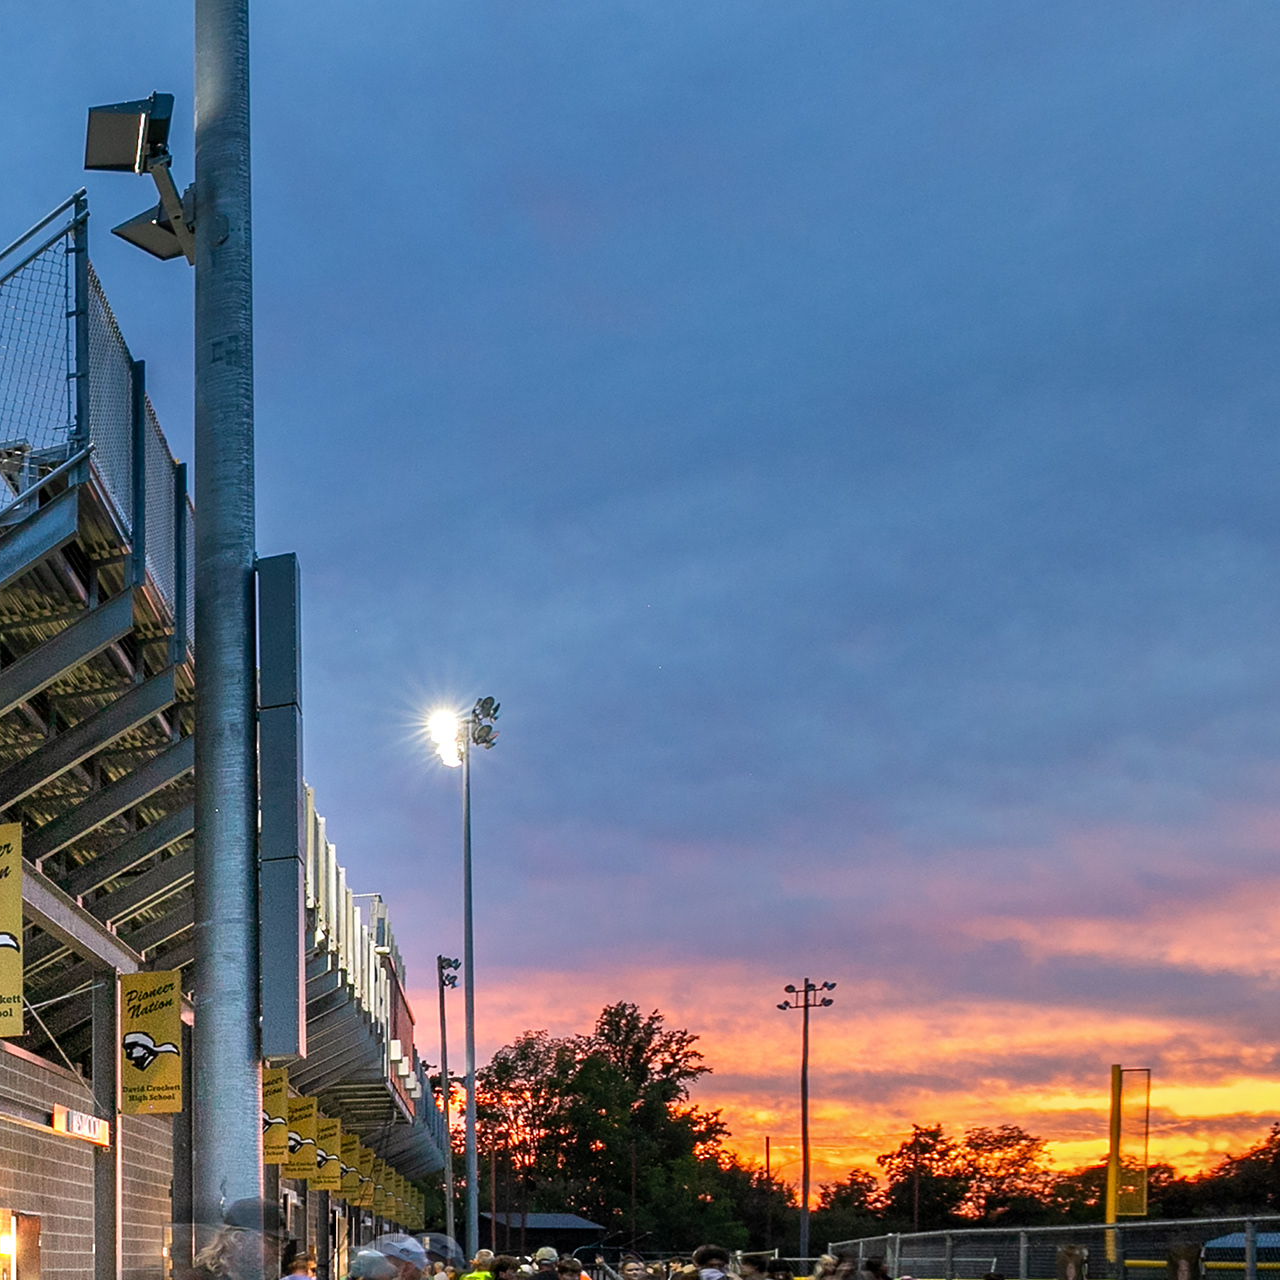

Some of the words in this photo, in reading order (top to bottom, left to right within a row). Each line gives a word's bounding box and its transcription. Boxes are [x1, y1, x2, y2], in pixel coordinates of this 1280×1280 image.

[126, 983, 175, 1006] Pioneer
[128, 998, 173, 1019] Nation
[129, 1094, 148, 1103] High
[149, 1093, 175, 1101] School
